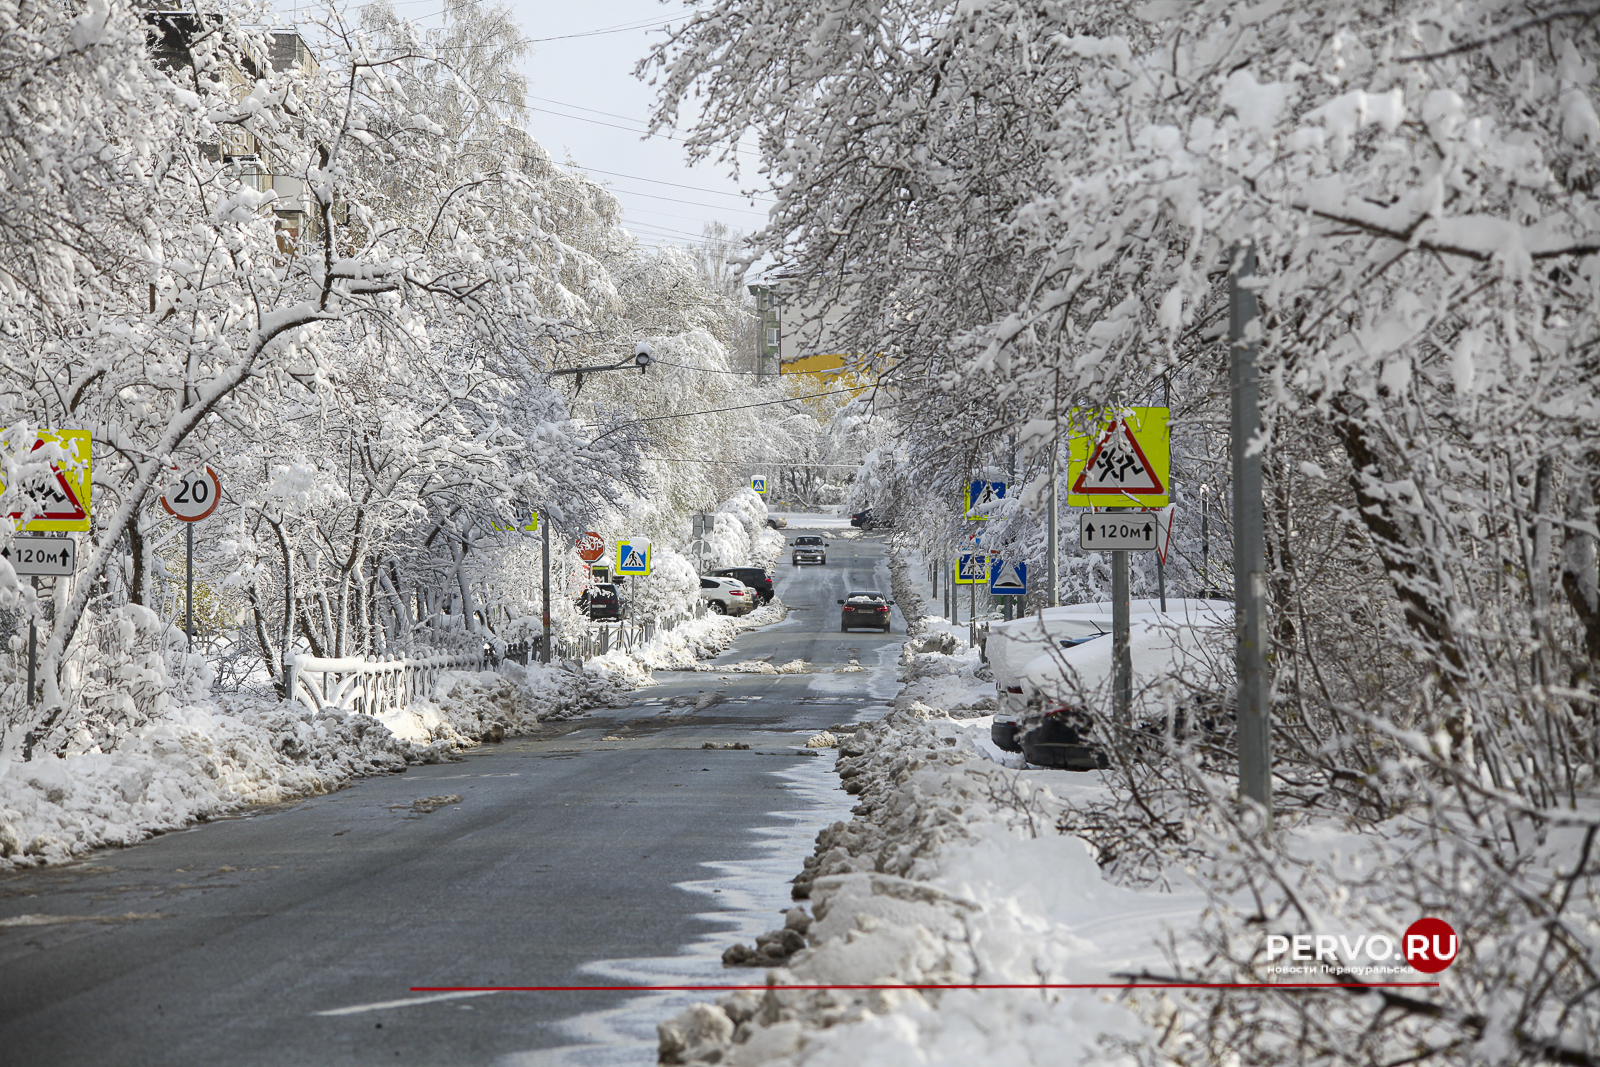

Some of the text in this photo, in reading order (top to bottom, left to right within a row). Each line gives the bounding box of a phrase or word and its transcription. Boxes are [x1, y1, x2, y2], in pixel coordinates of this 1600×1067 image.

[174, 480, 208, 503] 20
[1100, 525, 1140, 538] 120м
[16, 549, 57, 563] 120м
